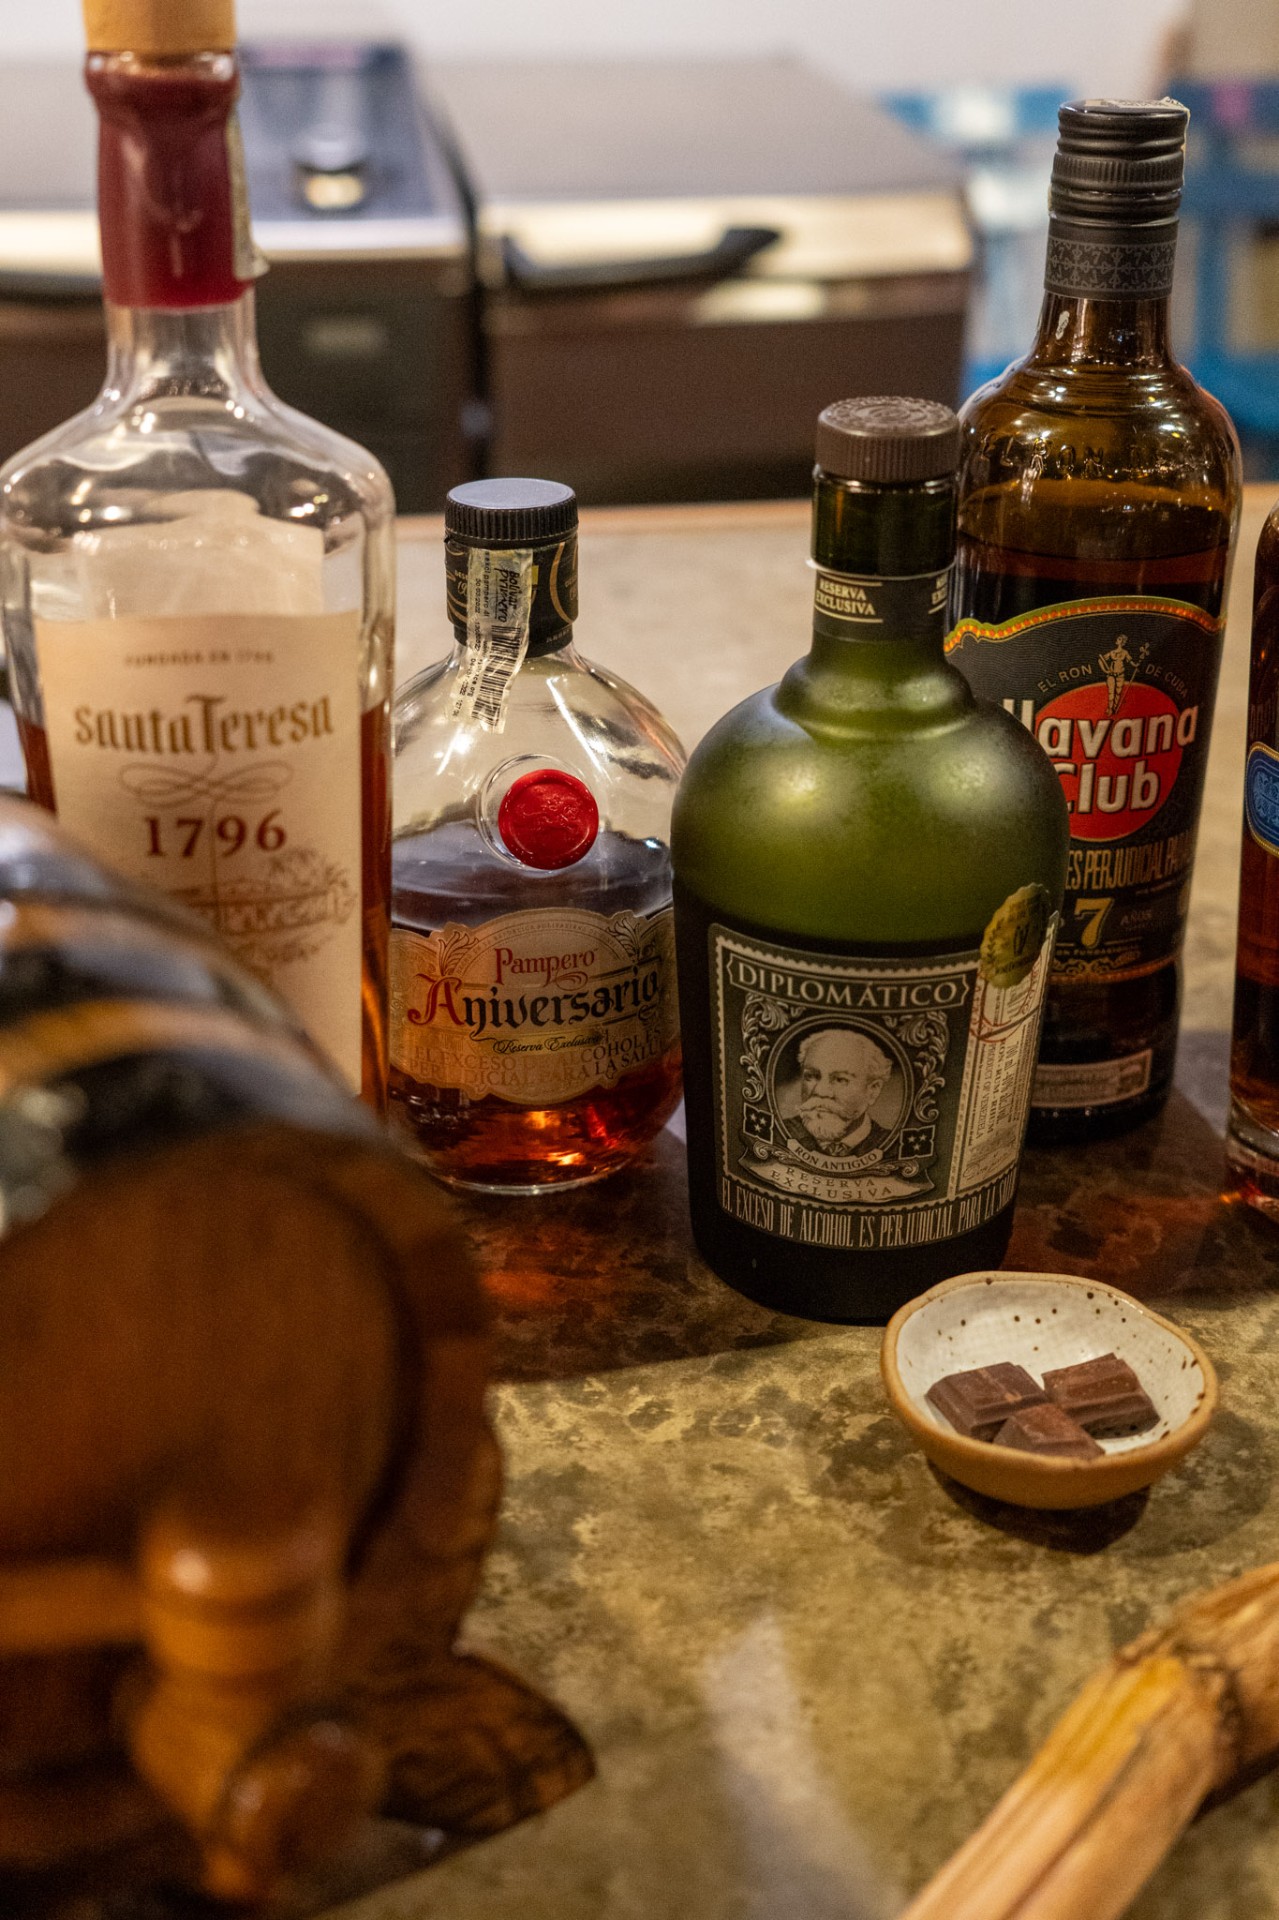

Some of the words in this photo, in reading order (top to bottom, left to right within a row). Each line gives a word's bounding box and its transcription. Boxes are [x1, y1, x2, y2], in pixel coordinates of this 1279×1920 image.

[815, 589, 876, 616] EXCLUSIVA
[820, 578, 868, 601] RESERVA
[1037, 678, 1057, 693] EL
[1058, 663, 1093, 683] RON
[1145, 663, 1163, 679] DE
[1164, 671, 1189, 699] CUBA
[184, 694, 334, 755] Teresa
[145, 808, 287, 859] 1796
[1083, 841, 1163, 891] PERJUDICIAL
[1073, 897, 1115, 949] 7
[494, 946, 596, 988] Pampero
[407, 966, 660, 1041] Aniversario
[440, 1050, 517, 1071] EXCESO
[492, 1039, 543, 1055] Reserva
[595, 1058, 618, 1076] LA
[795, 1147, 820, 1166] RON
[822, 1152, 878, 1171] ANTIGUO
[770, 1170, 892, 1199] EXCLUSIVA
[786, 1167, 875, 1188] RESERVA
[736, 1184, 774, 1232] EXCESO
[779, 1203, 795, 1238] DE
[800, 1210, 853, 1247] ALCOHOL
[859, 1215, 875, 1248] ES
[879, 1204, 953, 1248] PERJUDICIAL
[957, 1193, 982, 1233] PARA
